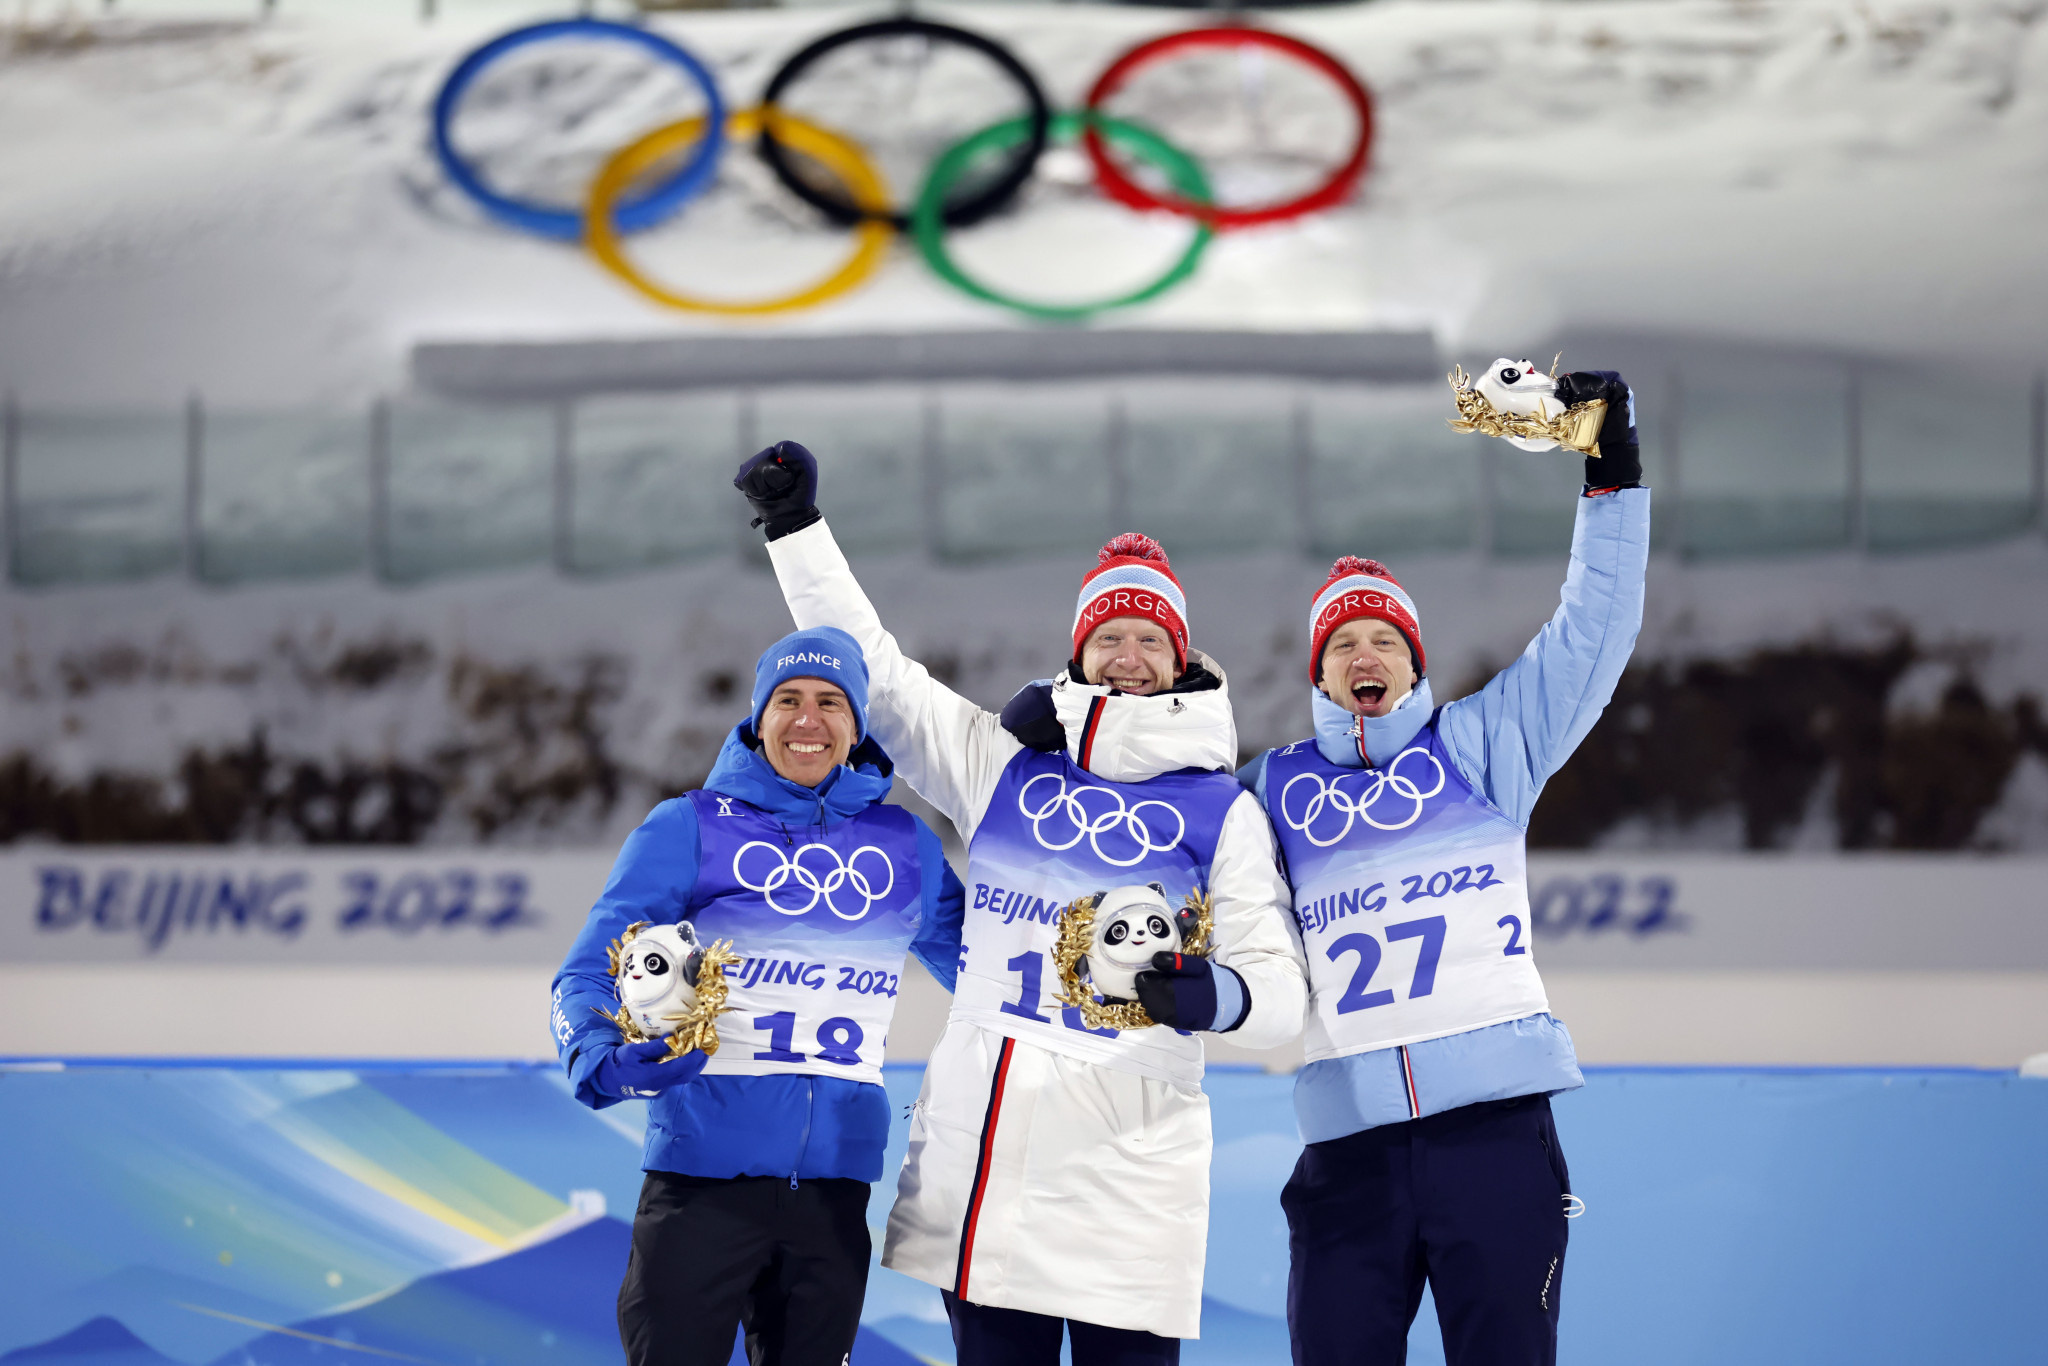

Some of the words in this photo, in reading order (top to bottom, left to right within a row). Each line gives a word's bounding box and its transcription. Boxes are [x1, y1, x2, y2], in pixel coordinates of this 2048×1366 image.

[1083, 592, 1169, 628] NORGE
[1317, 594, 1398, 635] NORGE
[777, 652, 841, 670] FRANCE
[1401, 864, 1505, 904] 2022
[34, 865, 306, 955] BEIJING
[335, 868, 548, 937] 2022
[1530, 872, 1692, 940] 022
[1496, 915, 1526, 956] 2
[721, 958, 826, 990] EIJING
[837, 967, 898, 998] 2022
[1326, 915, 1447, 1015] 27
[753, 1011, 863, 1065] 18
